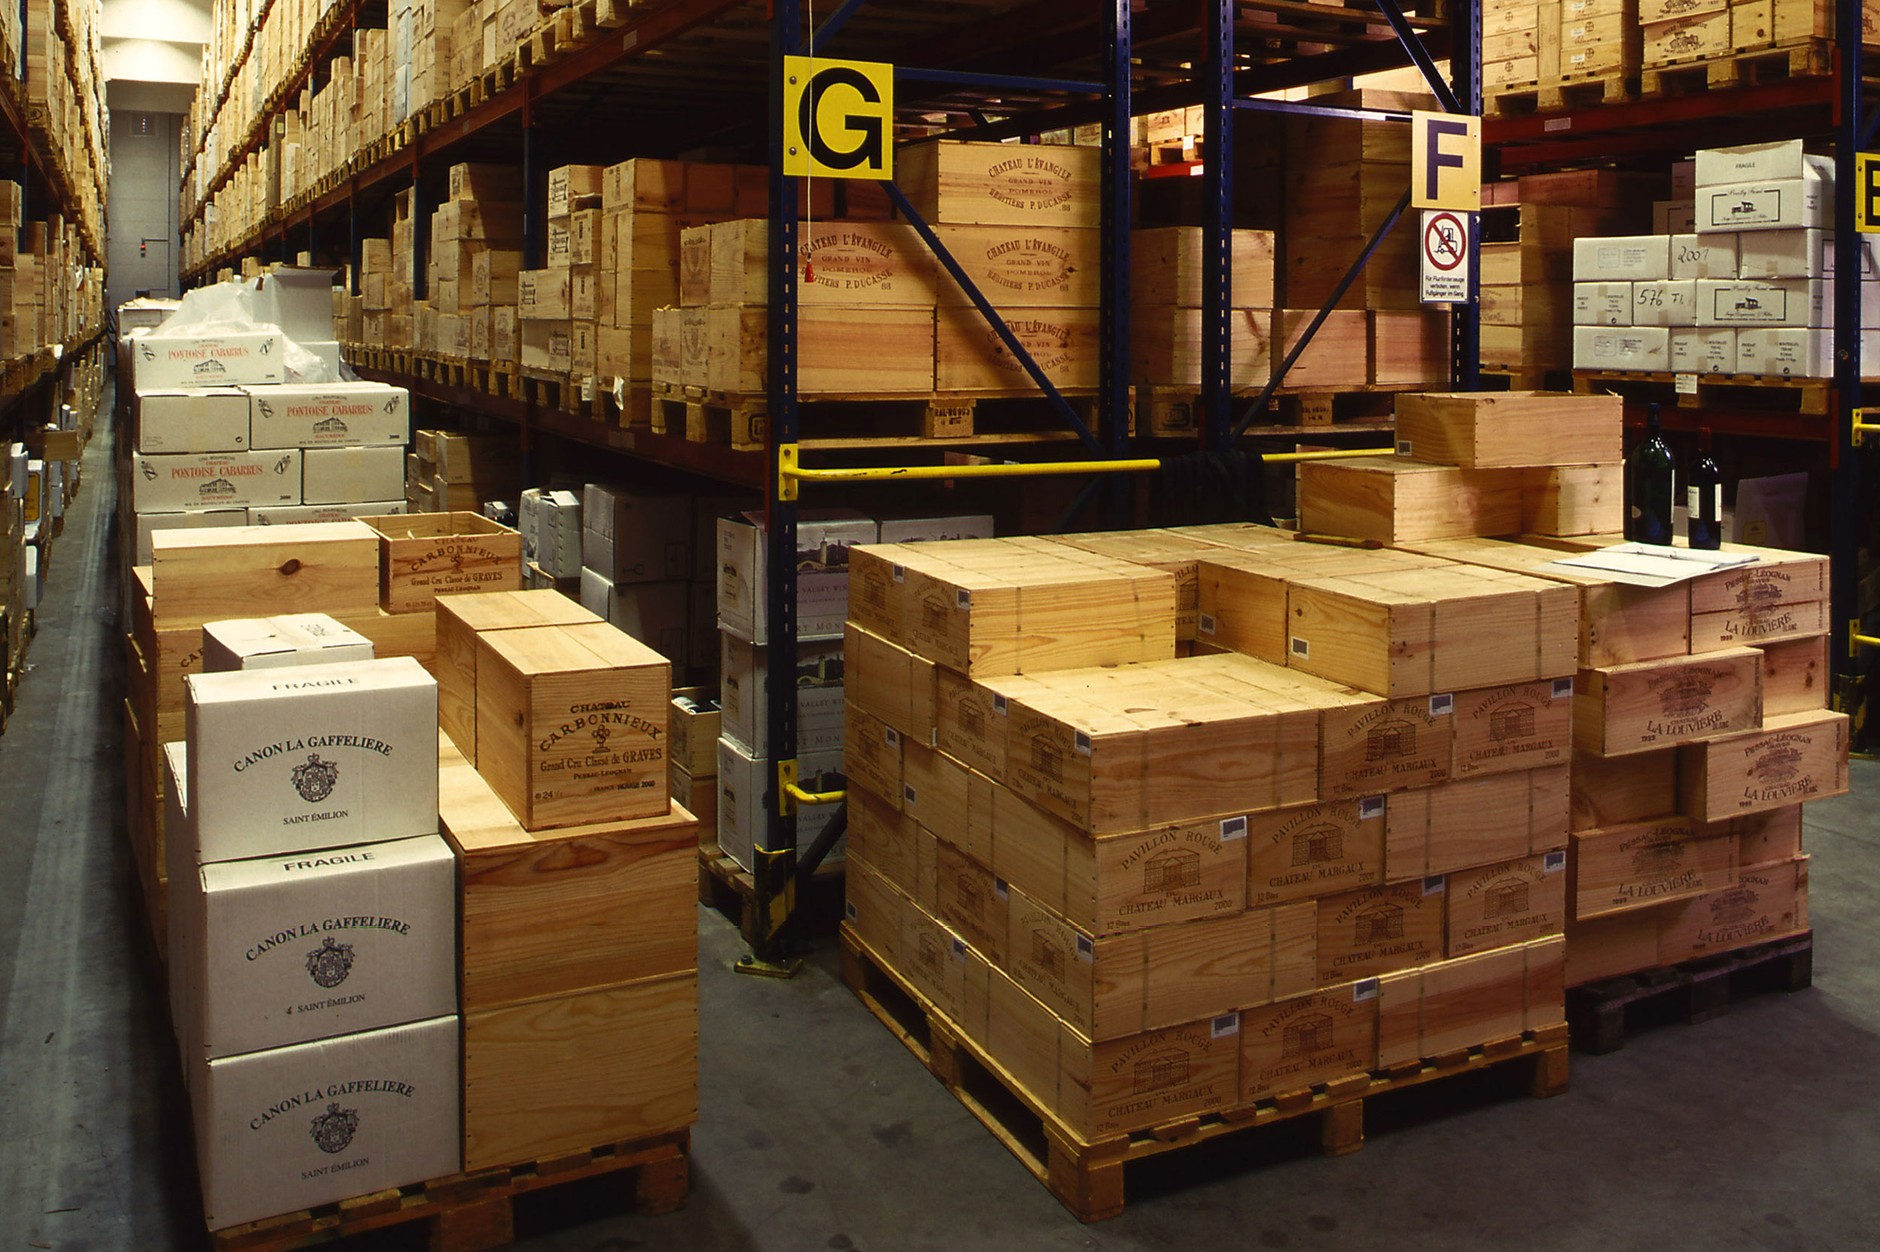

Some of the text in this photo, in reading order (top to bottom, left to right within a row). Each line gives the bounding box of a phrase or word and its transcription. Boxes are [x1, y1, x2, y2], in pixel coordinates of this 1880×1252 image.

[799, 67, 882, 170] G
[988, 158, 1071, 182] CHATEAU L'ÉVANGILE
[1426, 119, 1467, 200] F
[800, 233, 892, 258] CHATEAU L'ÉVANGILE
[986, 238, 1069, 262] CHATEAU L'ÉVANGILE
[168, 348, 249, 360] PONTOISE CABARRUS
[287, 404, 373, 416] PONTOISE CABARRUS
[172, 465, 263, 478] PONTOISE CABARRUS
[411, 545, 503, 572] CARBONNIEUX
[411, 577, 429, 586] Grand
[432, 576, 442, 585] Cru
[464, 574, 470, 582] de
[473, 571, 502, 582] GRAVES
[802, 583, 828, 593] VALLEY
[1725, 620, 1738, 634] LA
[272, 678, 361, 691] FRAGILE
[570, 701, 631, 714] CHATEAU
[1472, 686, 1552, 719] PAVILLON ROUGE
[540, 713, 663, 752] CARBONNIEUX
[1347, 704, 1436, 737] PAVILLON ROUGE
[1648, 720, 1662, 735] LA
[234, 735, 393, 773] CANON LA GAFFELIERE
[540, 758, 564, 772] Grand
[567, 758, 582, 769] Cru
[612, 754, 620, 764] de
[622, 748, 662, 763] GRAVES
[1470, 740, 1553, 760] CHATEAU MARGAUX
[1345, 760, 1436, 780] CHATEAU MARGAUX
[1744, 786, 1758, 800] LA
[283, 809, 348, 825] SAINT ÉMILION
[1272, 806, 1362, 844] PAVILLON ROUGE
[283, 852, 375, 871] FRAGILE
[1121, 831, 1223, 870] PAVILLON ROUGE
[1270, 862, 1364, 888] CHATEAU MARGAUX
[1467, 863, 1546, 898] PAVILLON ROUGE
[1619, 883, 1633, 896] LA
[1119, 889, 1223, 915] CHATEAU MARGAUX
[1214, 900, 1232, 910] 2000
[1336, 887, 1423, 924] PAVILLON ROUGE
[1465, 913, 1547, 938] CHATEAU MARGAUX
[1698, 929, 1712, 942] LA
[246, 916, 411, 962] CANON LA GAFFELIERE
[1333, 940, 1424, 967] CHATEAU MARGAUX
[297, 993, 366, 1014] SAINT ÉMILION
[1262, 997, 1354, 1037] PAVILLON ROUGE
[1111, 1031, 1212, 1073] PAVILLON ROUGE
[1260, 1049, 1354, 1080] CHATEAU MARGAUX
[250, 1080, 415, 1131] CANON LA GAFFELIERE
[1108, 1085, 1213, 1118] CHATEAU MARGAUX
[301, 1157, 369, 1180] SAINT ÉMILION
